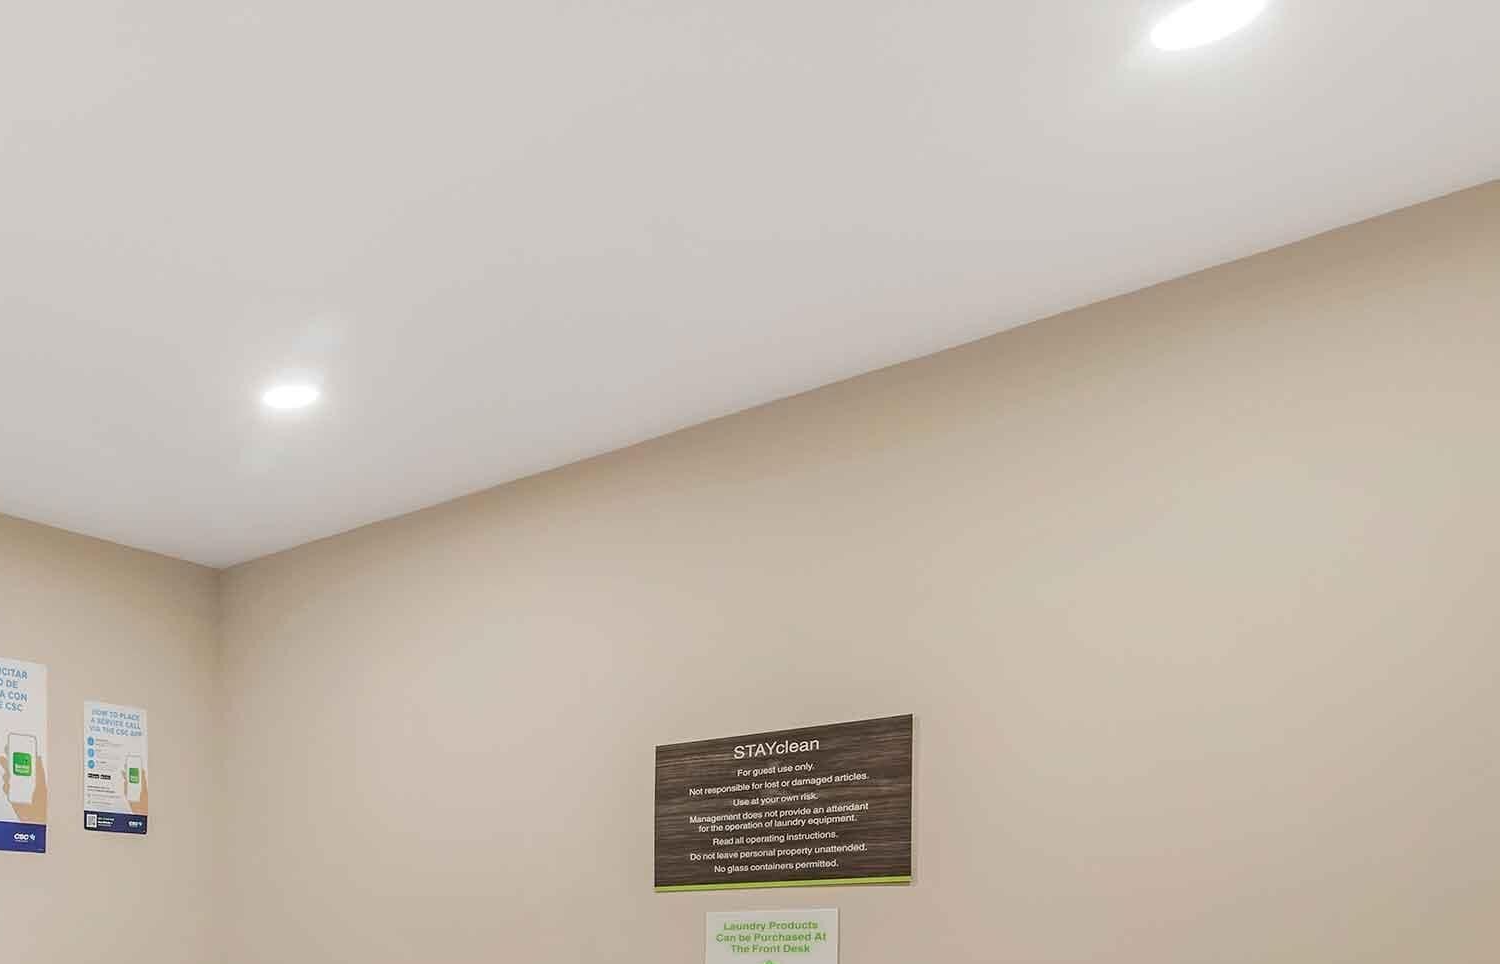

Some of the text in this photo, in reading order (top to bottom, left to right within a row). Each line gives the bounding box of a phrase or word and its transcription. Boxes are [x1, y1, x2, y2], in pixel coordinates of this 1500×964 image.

[6, 680, 19, 688] DE
[8, 691, 28, 702] CON
[5, 702, 23, 712] CSC
[733, 739, 820, 759] STAYclean
[737, 762, 815, 777] For guest use only.
[689, 788, 703, 796] Not
[704, 783, 750, 794] responsible
[751, 782, 762, 790] for
[764, 780, 780, 789] lost
[791, 775, 833, 786] damaged
[834, 772, 869, 782] articles.
[760, 797, 780, 806] your
[690, 813, 741, 824] Management
[764, 810, 778, 818] not
[780, 808, 811, 818] provide
[826, 802, 869, 813] attendant
[710, 824, 723, 832] the
[725, 822, 763, 832] operation
[774, 818, 806, 827] laundry
[808, 814, 858, 826] equipment.
[713, 832, 839, 845] Read all operating instructions.
[690, 853, 701, 861] Do
[740, 849, 776, 859] personal
[777, 847, 812, 857] property
[814, 843, 868, 853] unattended.
[714, 859, 839, 874] No glass containers permitted.
[723, 920, 818, 931] Laundry Products
[716, 932, 827, 942] Can be Purchased At
[731, 944, 811, 953] The Front Desk
